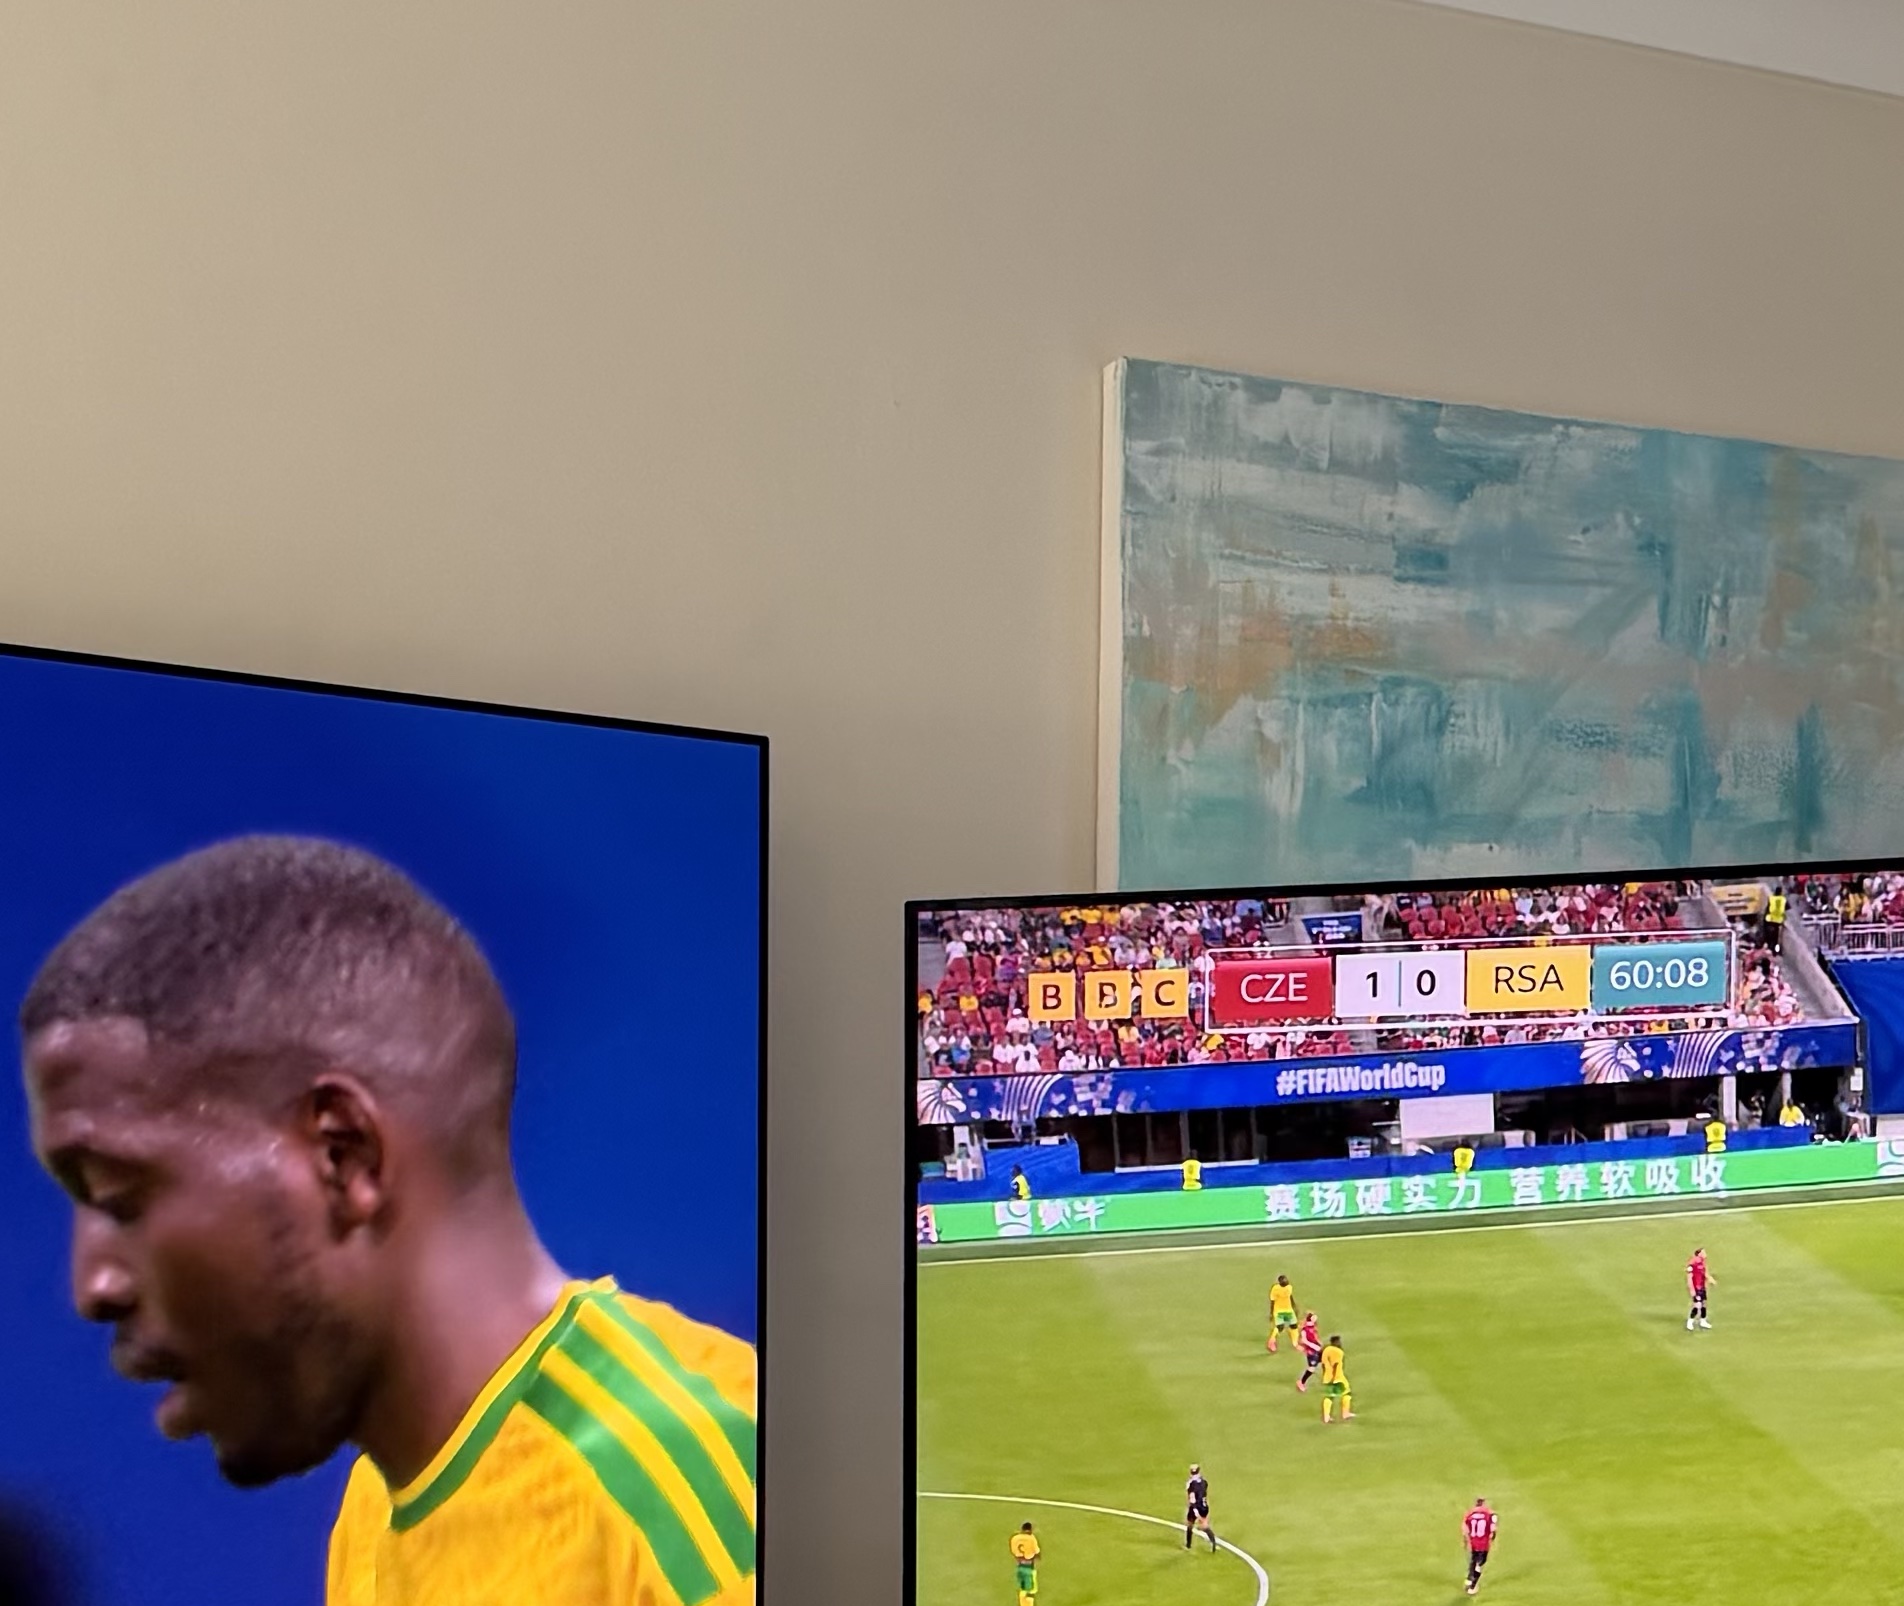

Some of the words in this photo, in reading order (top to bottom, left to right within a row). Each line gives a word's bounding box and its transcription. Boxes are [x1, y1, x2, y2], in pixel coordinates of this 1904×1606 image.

[1239, 971, 1309, 1003] CZE
[1365, 971, 1379, 999] 1
[1415, 969, 1437, 997] 0
[1494, 963, 1565, 995] RSA
[1609, 957, 1710, 991] 60:08
[1275, 1061, 1446, 1097] #FIFAWorldCup
[1264, 1173, 1484, 1223] 赛场硬实力
[1508, 1153, 1728, 1207] 营养软吸收
